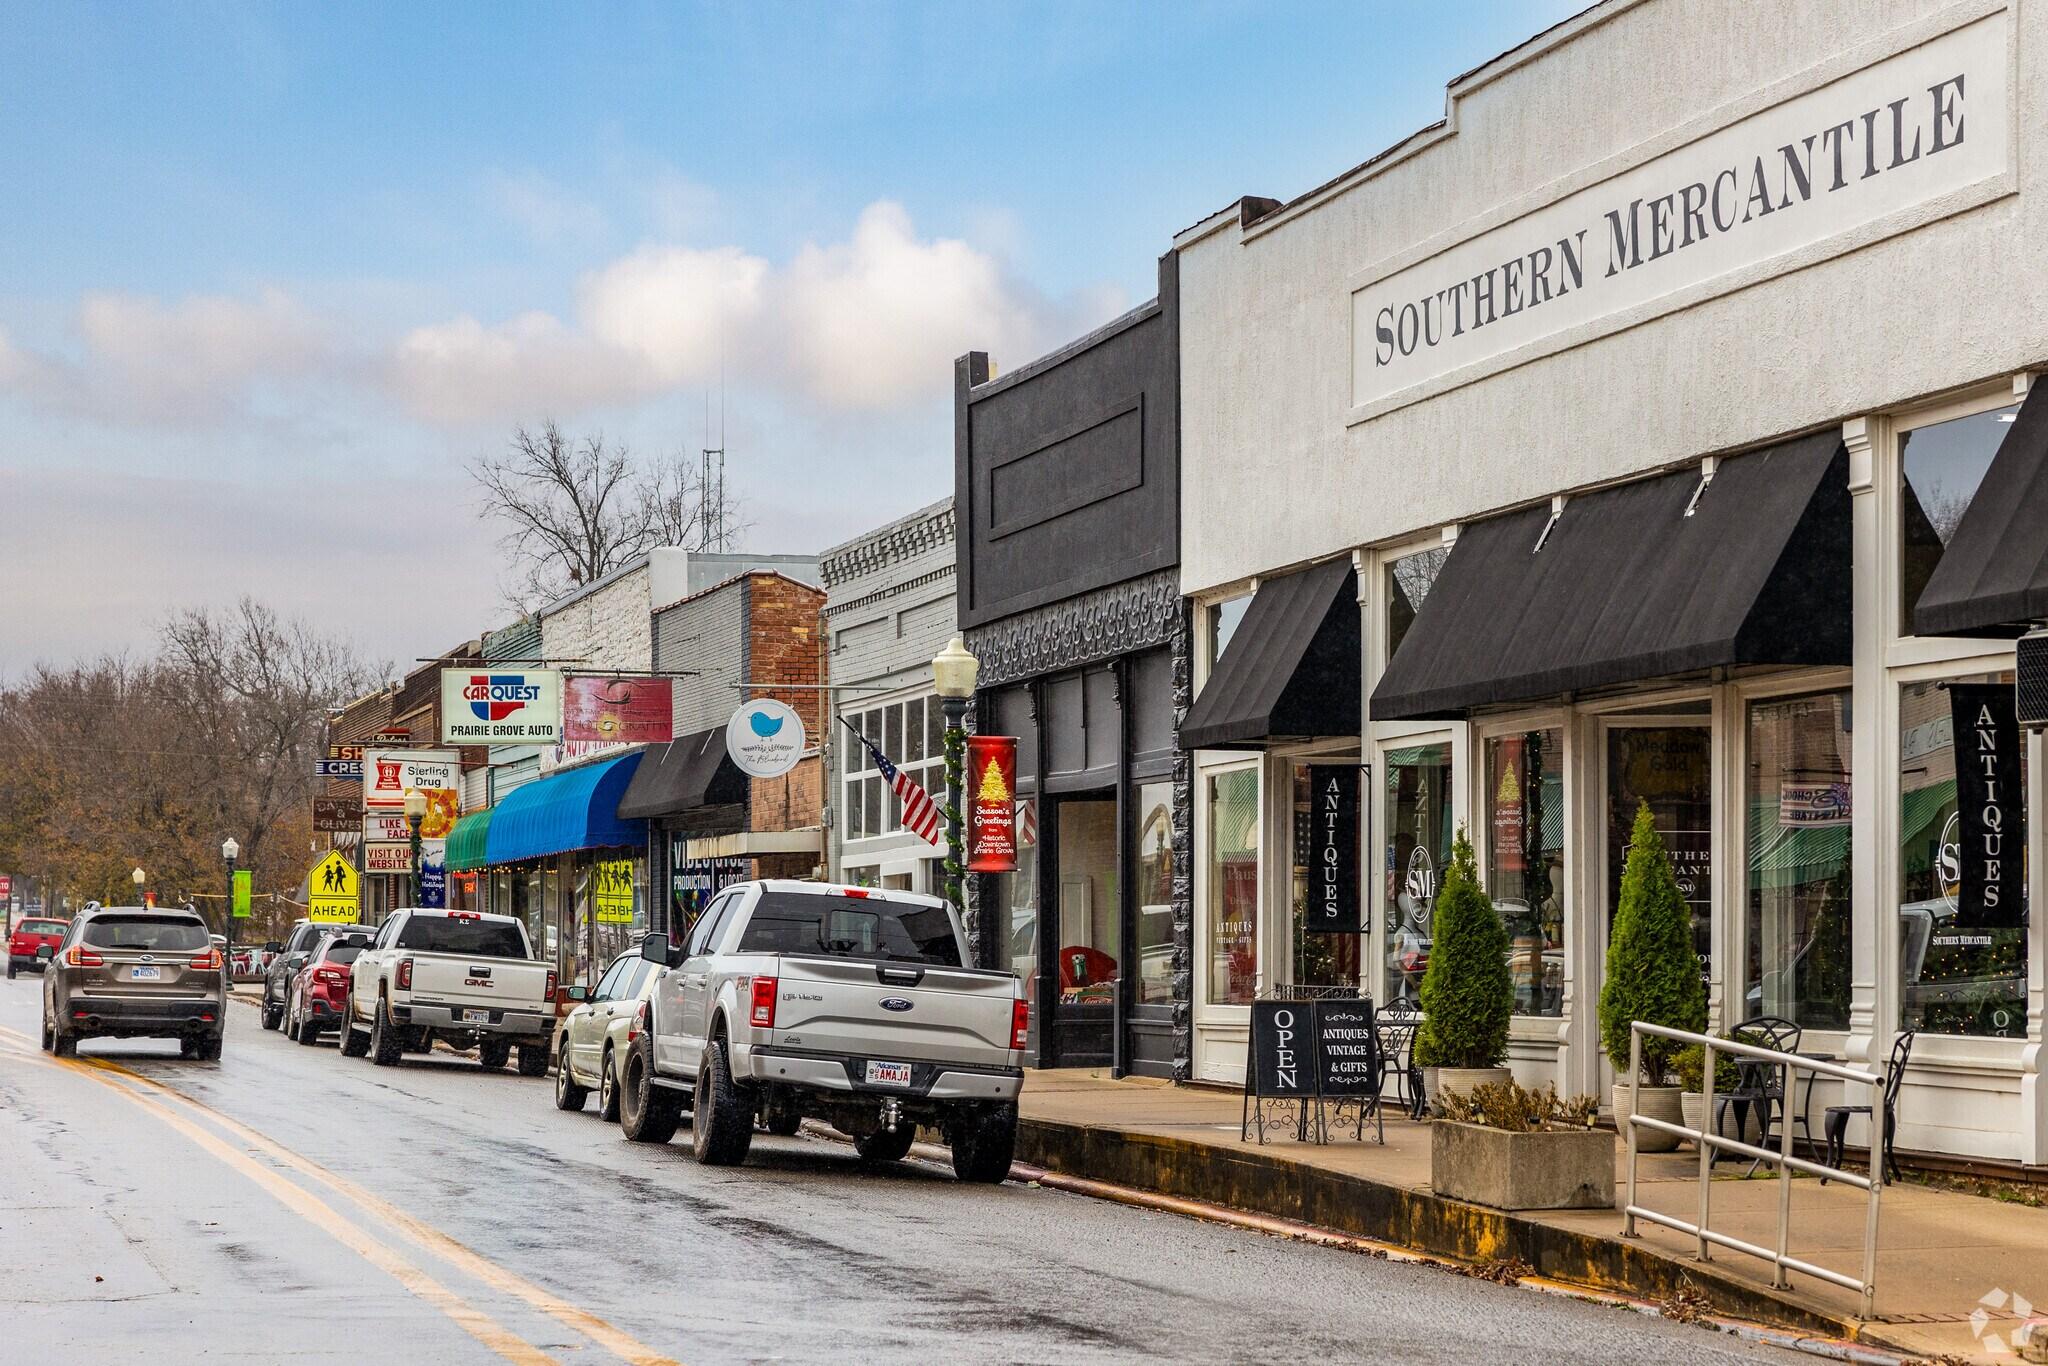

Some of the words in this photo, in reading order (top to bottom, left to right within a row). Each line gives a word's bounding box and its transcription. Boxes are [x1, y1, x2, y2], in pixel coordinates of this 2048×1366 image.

[1375, 230, 1588, 368] SOUTHERN
[1603, 73, 1966, 279] MERCANTILE
[451, 725, 490, 736] PRAIRIE
[493, 725, 525, 736] GROVE
[528, 725, 553, 736] AUTO
[408, 766, 449, 778] Sterling
[415, 777, 441, 788] Drug
[976, 805, 1010, 815] Season's
[1975, 703, 2003, 908] ANTIQUES
[337, 809, 345, 818] &
[320, 819, 362, 829] OLIVES
[379, 819, 401, 828] LIKE
[974, 816, 1012, 827] Greetings
[974, 846, 994, 854] Prairie
[1323, 776, 1341, 918] ANTIQUES
[368, 849, 391, 858] VISIT
[368, 859, 407, 869] WEBSITE
[673, 875, 711, 890] PRODUCTION
[1408, 869, 1433, 899] SM
[312, 906, 355, 917] AHEAD
[1215, 921, 1253, 935] ANTIQUES
[464, 978, 494, 988] GMC
[886, 1000, 908, 1010] Ford
[1322, 1028, 1369, 1042] ANTIQUES
[1273, 1009, 1297, 1090] OPEN
[1326, 1044, 1368, 1057] VINTAGE
[1331, 1062, 1339, 1073] &
[1339, 1061, 1369, 1074] GIFTS
[880, 1069, 909, 1082] AMAJA
